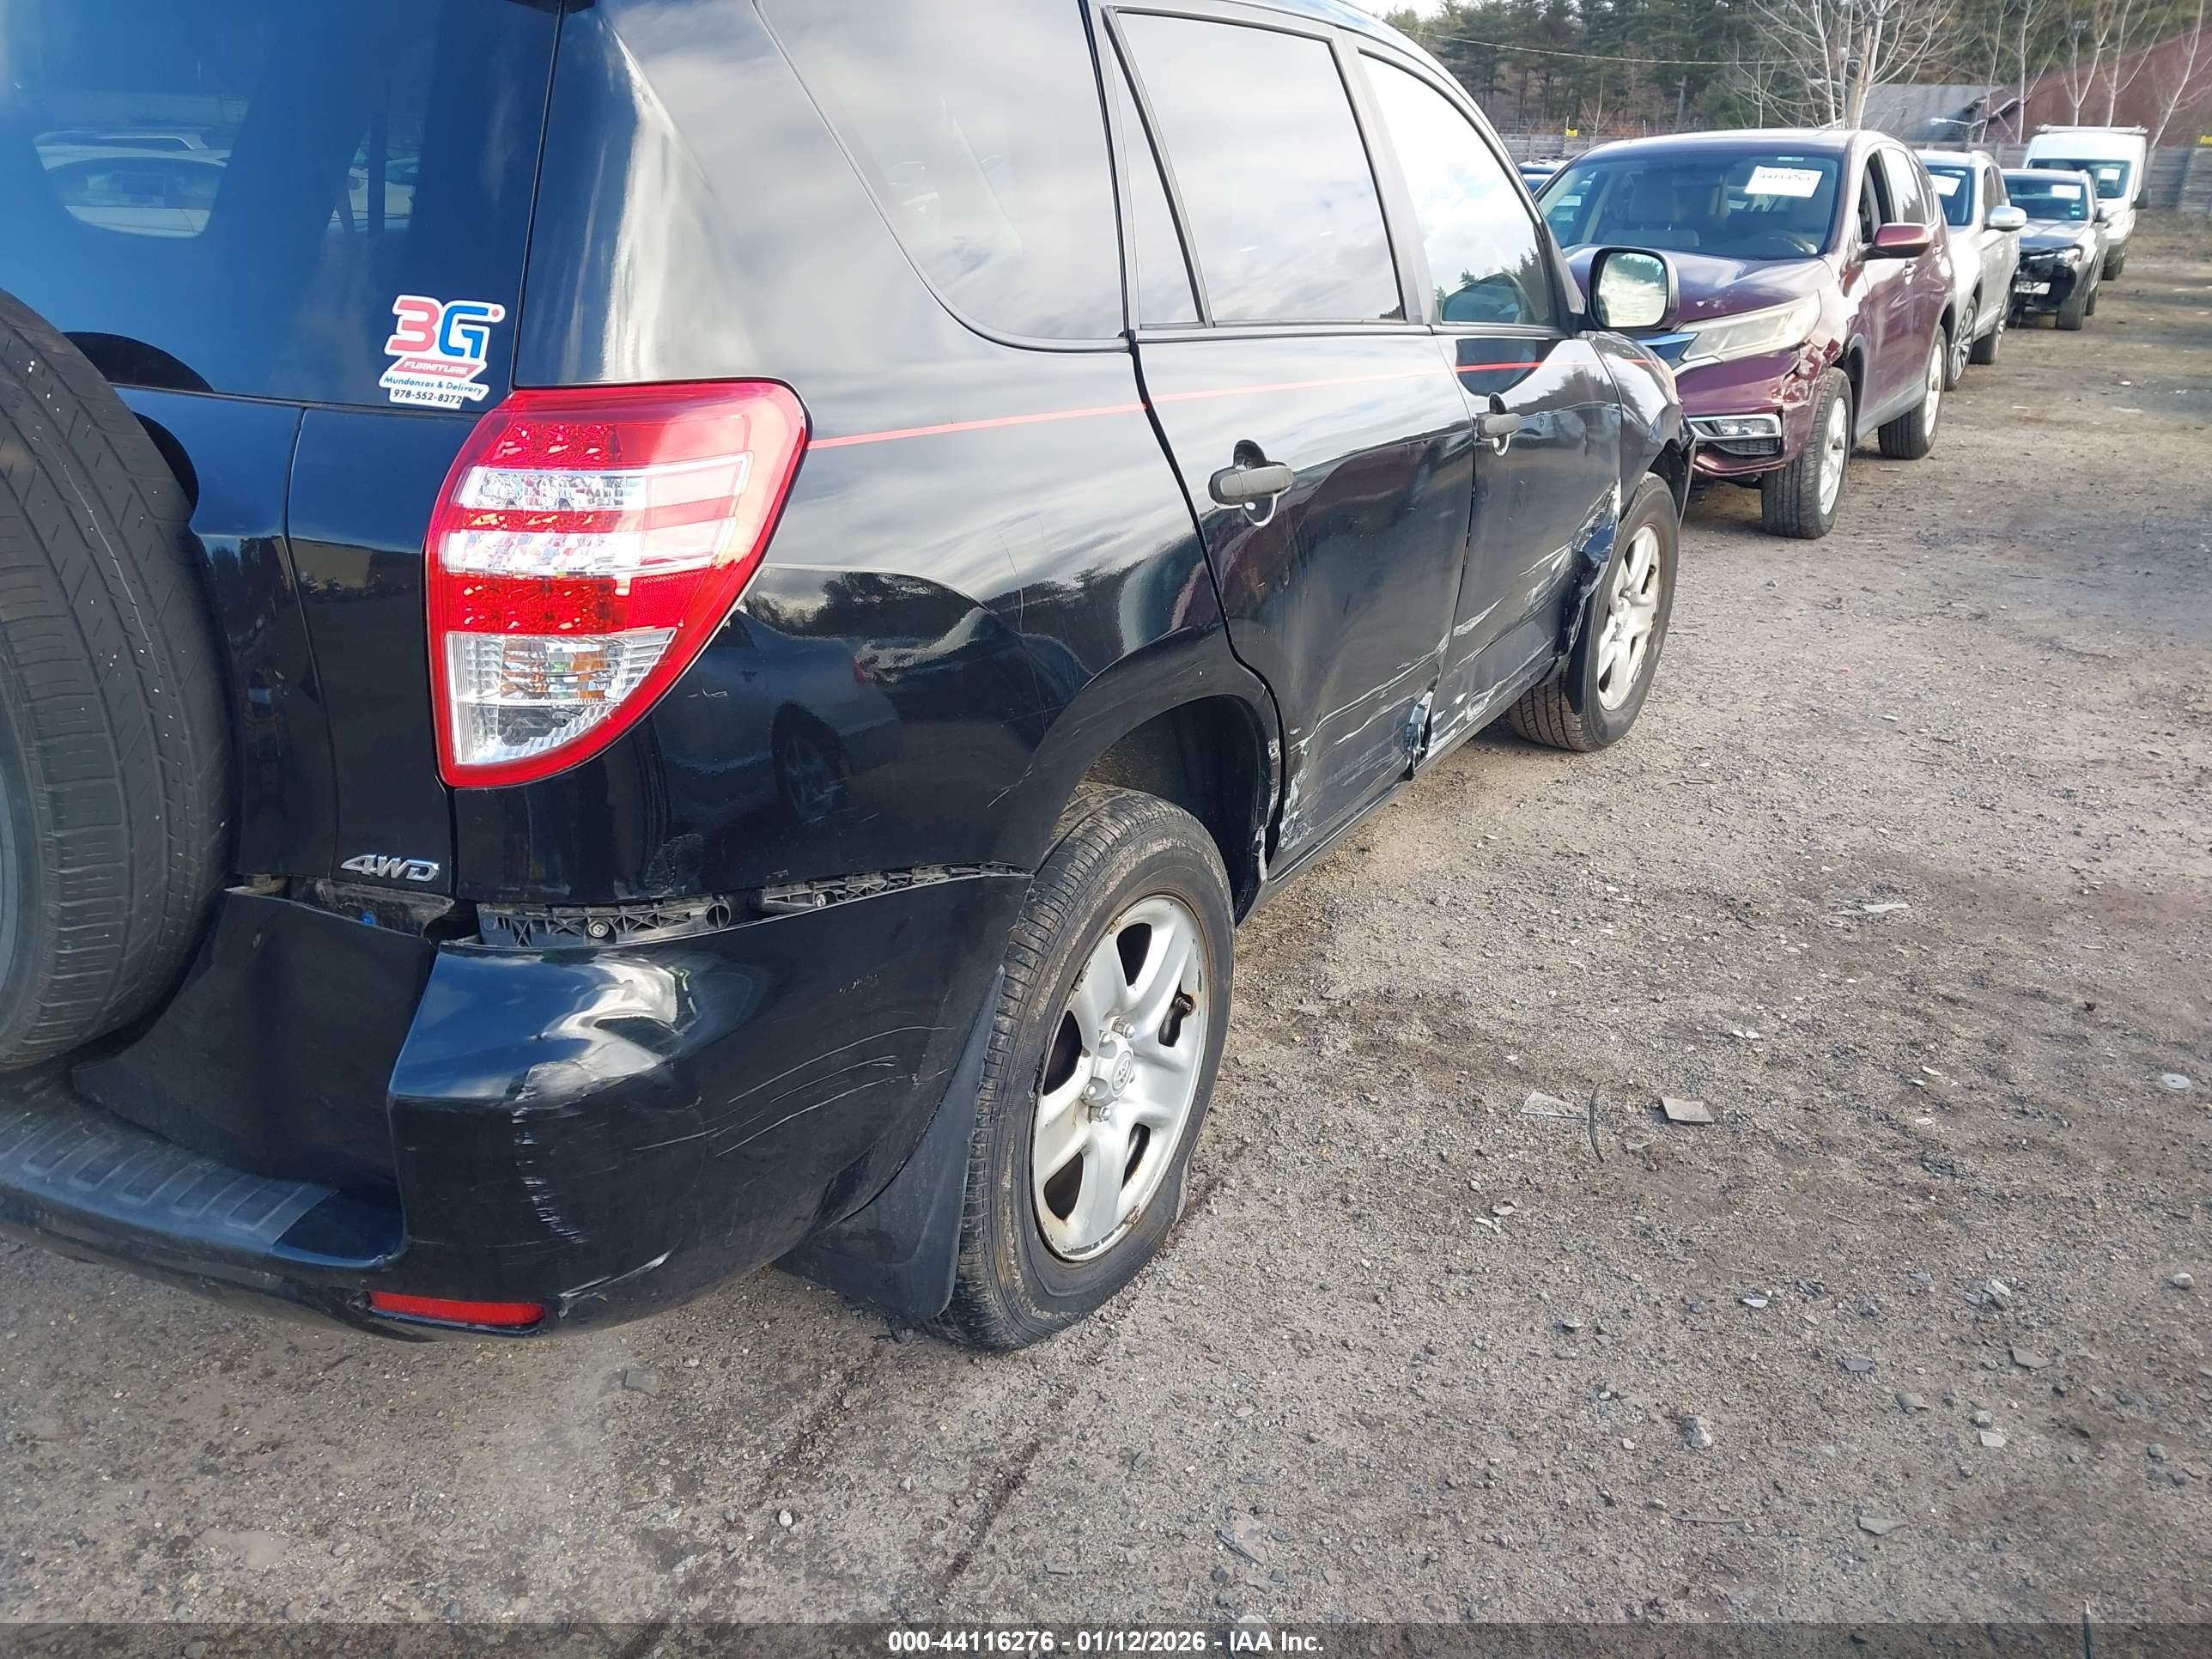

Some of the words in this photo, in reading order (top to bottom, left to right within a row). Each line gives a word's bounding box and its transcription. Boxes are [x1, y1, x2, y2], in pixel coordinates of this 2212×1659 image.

[389, 299, 489, 359] 3G
[404, 361, 469, 375] FURNITURE
[383, 376, 434, 388] Mundanzas
[446, 381, 483, 396] Delivery
[392, 388, 462, 404] 978-552-8372
[340, 854, 440, 882] 4WD
